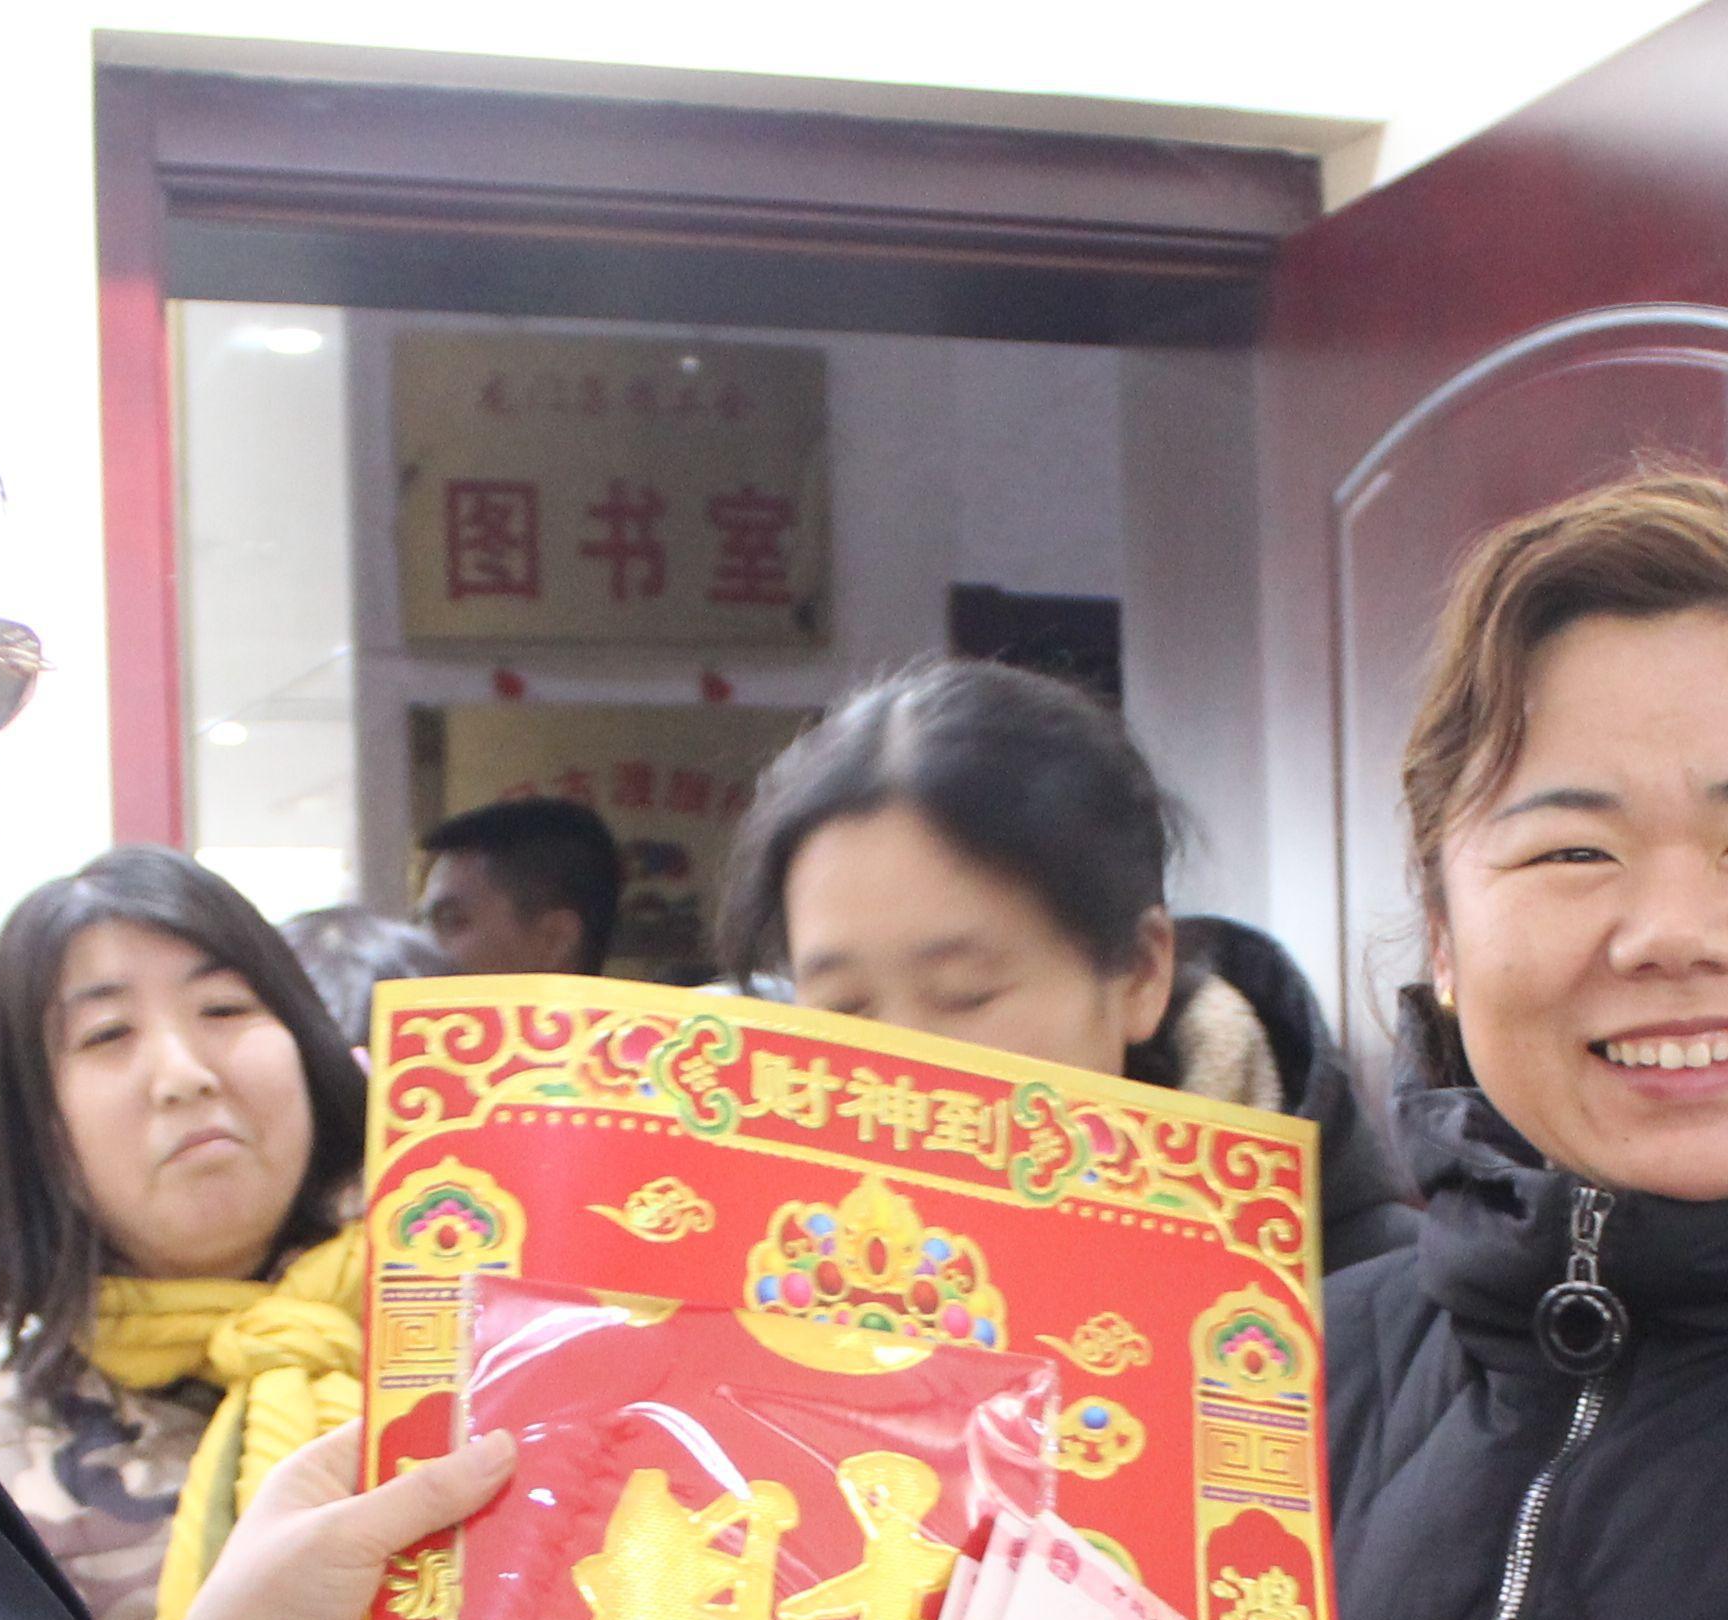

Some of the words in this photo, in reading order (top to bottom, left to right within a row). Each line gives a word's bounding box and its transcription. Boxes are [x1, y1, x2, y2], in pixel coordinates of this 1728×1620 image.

[444, 478, 798, 605] 图书室
[739, 1050, 1011, 1170] 财神到
